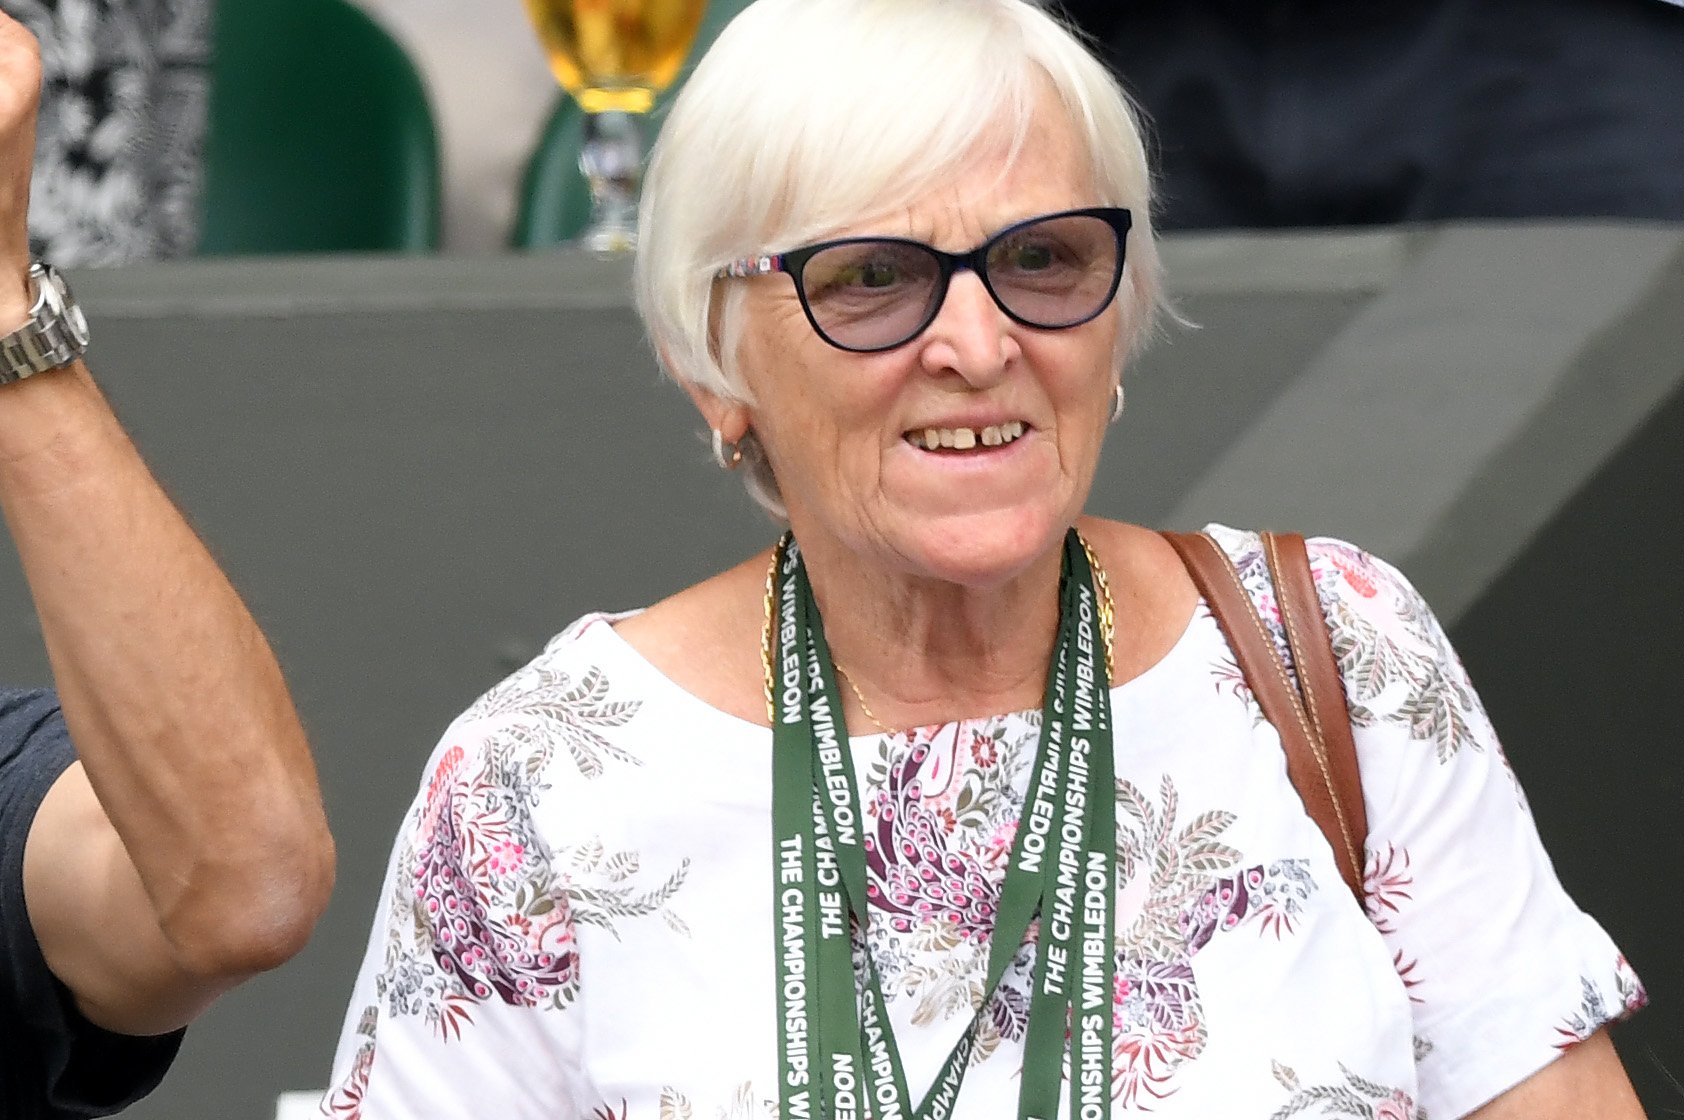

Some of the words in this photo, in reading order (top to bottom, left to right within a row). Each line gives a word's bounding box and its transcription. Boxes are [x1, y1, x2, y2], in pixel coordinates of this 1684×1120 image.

[781, 574, 803, 724] WIMBLEDON
[1072, 583, 1092, 731] WIMBLEDON
[809, 694, 857, 846] WIMBLEDON
[1051, 735, 1091, 943] CHAMPIONSHIPS
[780, 832, 803, 885] THE
[819, 890, 844, 940] THE
[1081, 851, 1108, 1010] WIMBLEDON
[781, 886, 810, 1087] CHAMPIONSHIPS
[1043, 943, 1068, 997] THE
